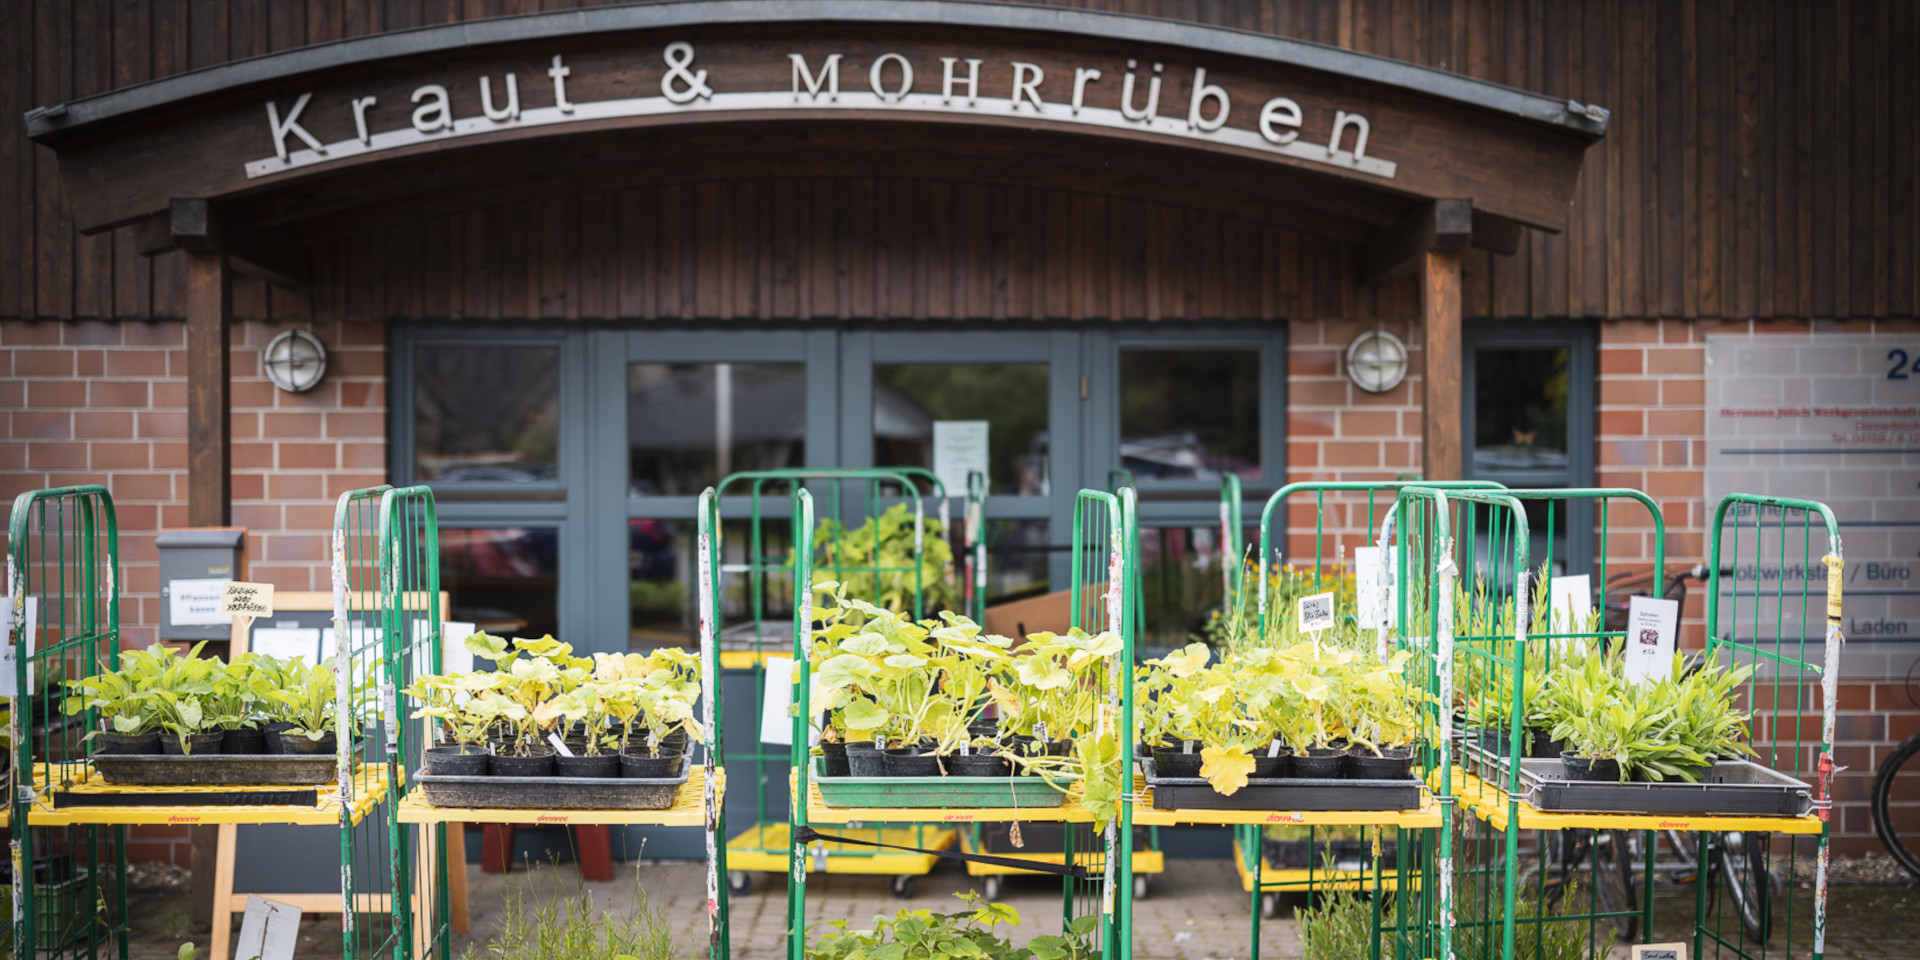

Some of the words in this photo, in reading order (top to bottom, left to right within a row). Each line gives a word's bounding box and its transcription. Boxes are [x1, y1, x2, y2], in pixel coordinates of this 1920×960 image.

[266, 54, 574, 163] Kraut
[660, 41, 714, 104] &
[786, 52, 1370, 162] MOHRrüben
[1866, 562, 1911, 581] Büro
[1851, 617, 1908, 635] Laden
